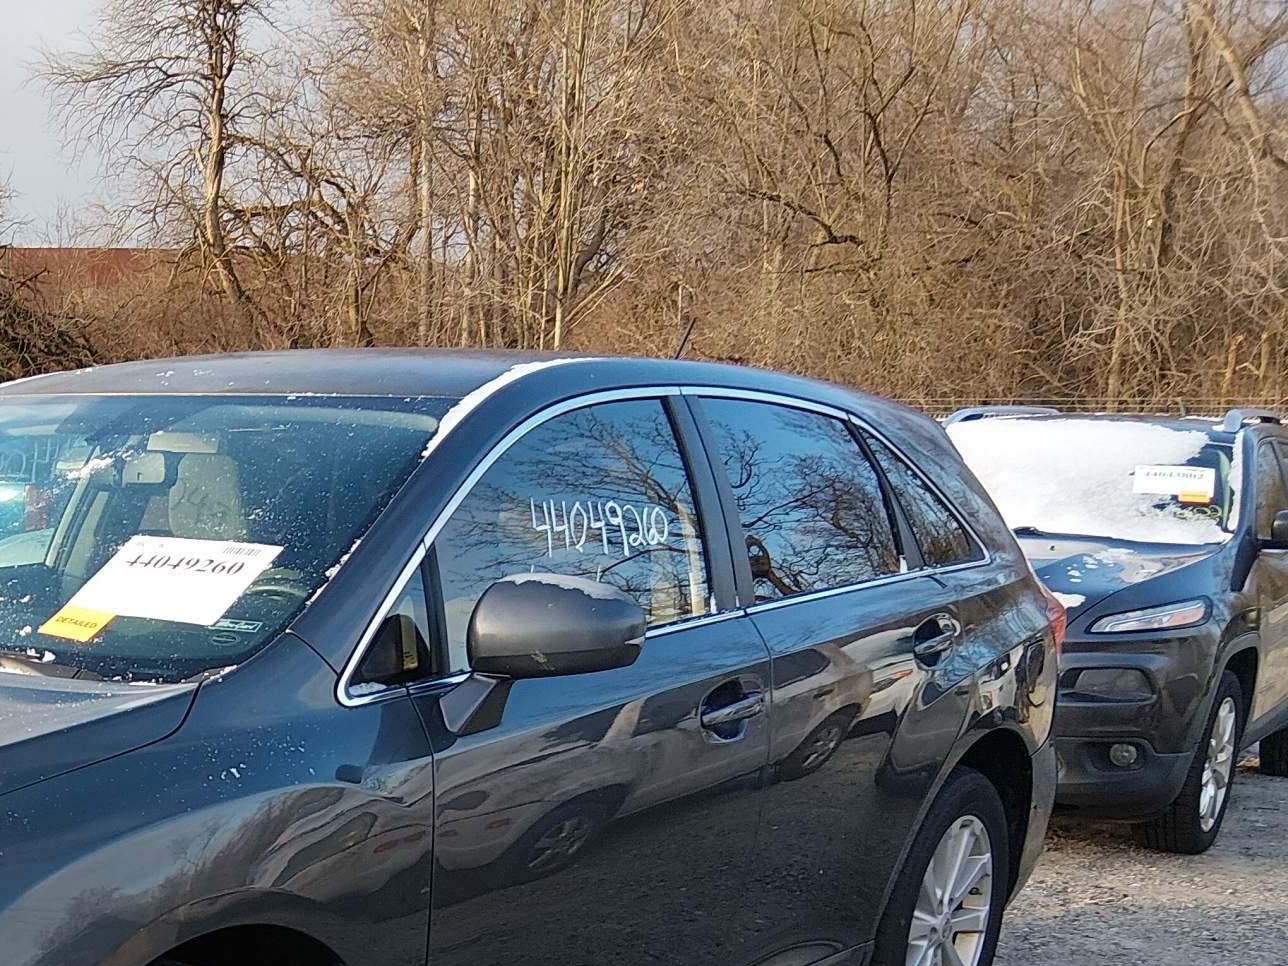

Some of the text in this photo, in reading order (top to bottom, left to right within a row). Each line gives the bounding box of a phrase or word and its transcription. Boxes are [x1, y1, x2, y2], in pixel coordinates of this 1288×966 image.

[530, 497, 669, 559] 44049260
[125, 553, 246, 576] 44049260
[56, 616, 98, 629] DETAILED
